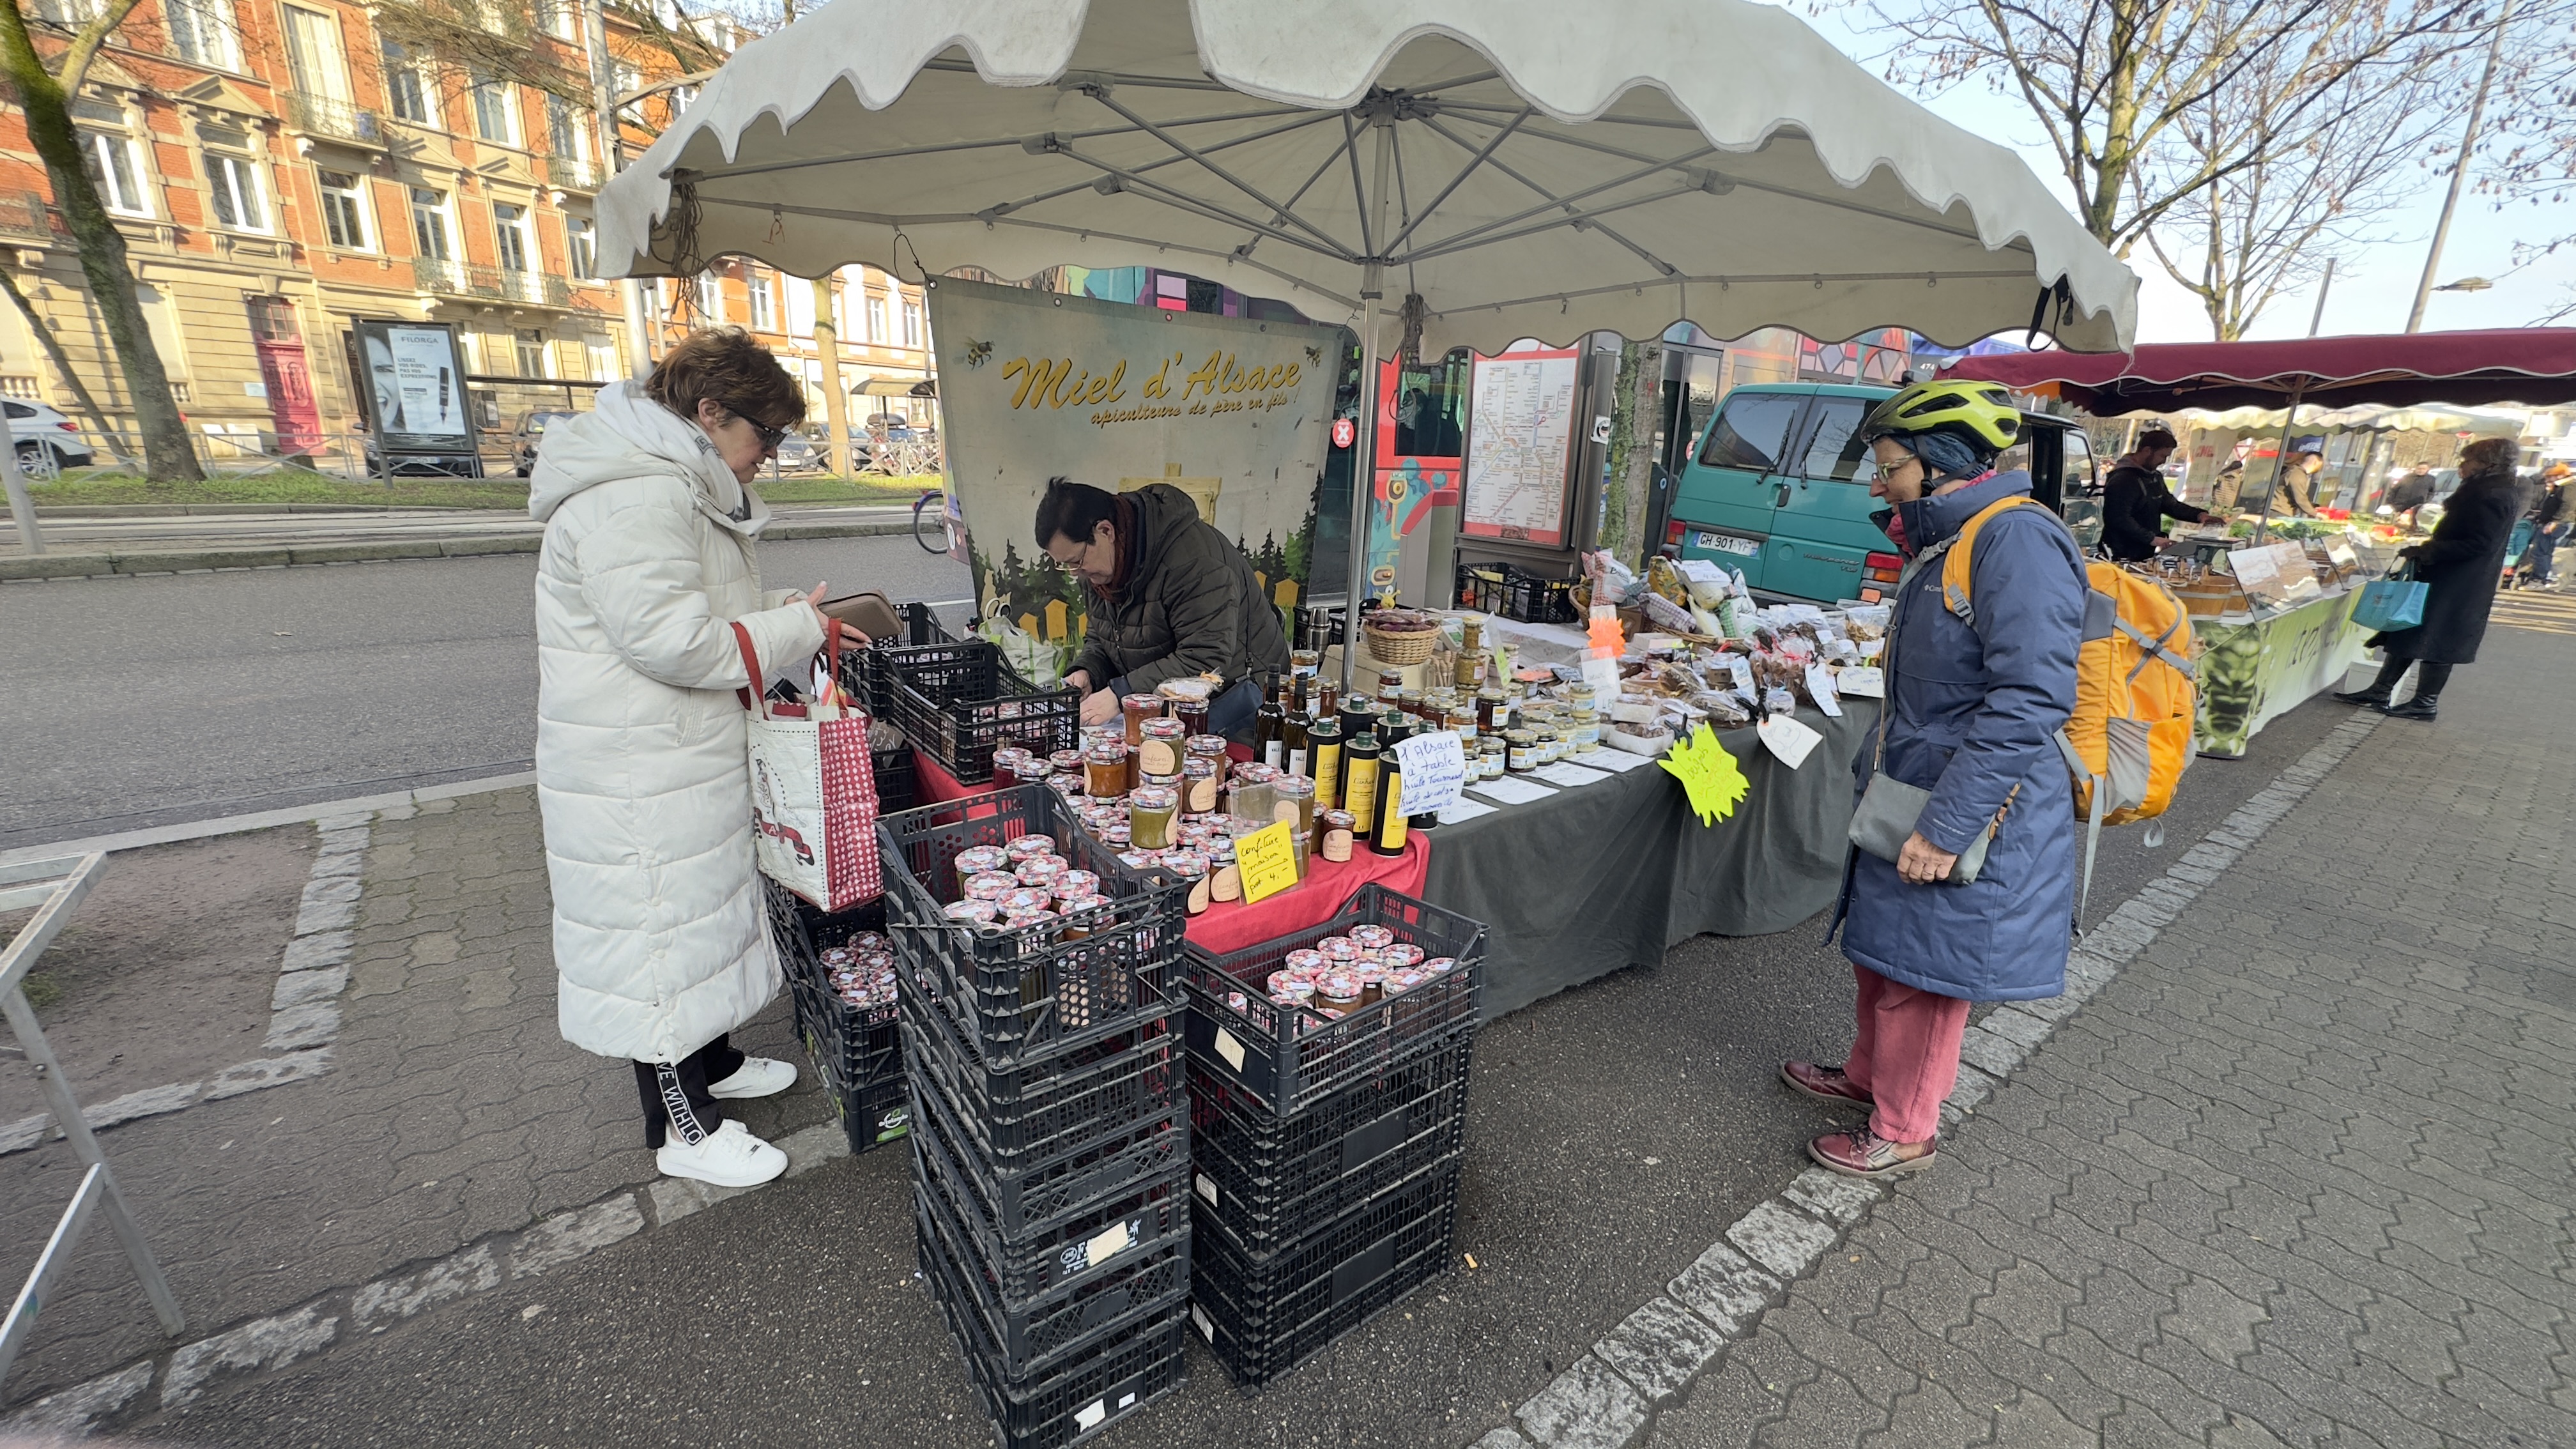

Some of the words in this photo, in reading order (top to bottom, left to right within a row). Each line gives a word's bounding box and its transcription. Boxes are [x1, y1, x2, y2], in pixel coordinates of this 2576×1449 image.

[1920, 362, 1935, 371] 474
[1002, 356, 1126, 410] Miel
[1142, 349, 1301, 401] d'Alsace
[1091, 402, 1182, 429] apiculteurs
[1188, 399, 1208, 415] de
[1210, 397, 1243, 418] père
[1248, 396, 1264, 410] en
[1266, 390, 1288, 413] fils
[1421, 753, 1456, 772] table
[1404, 775, 1426, 791] huile
[1241, 833, 1279, 858] confiture
